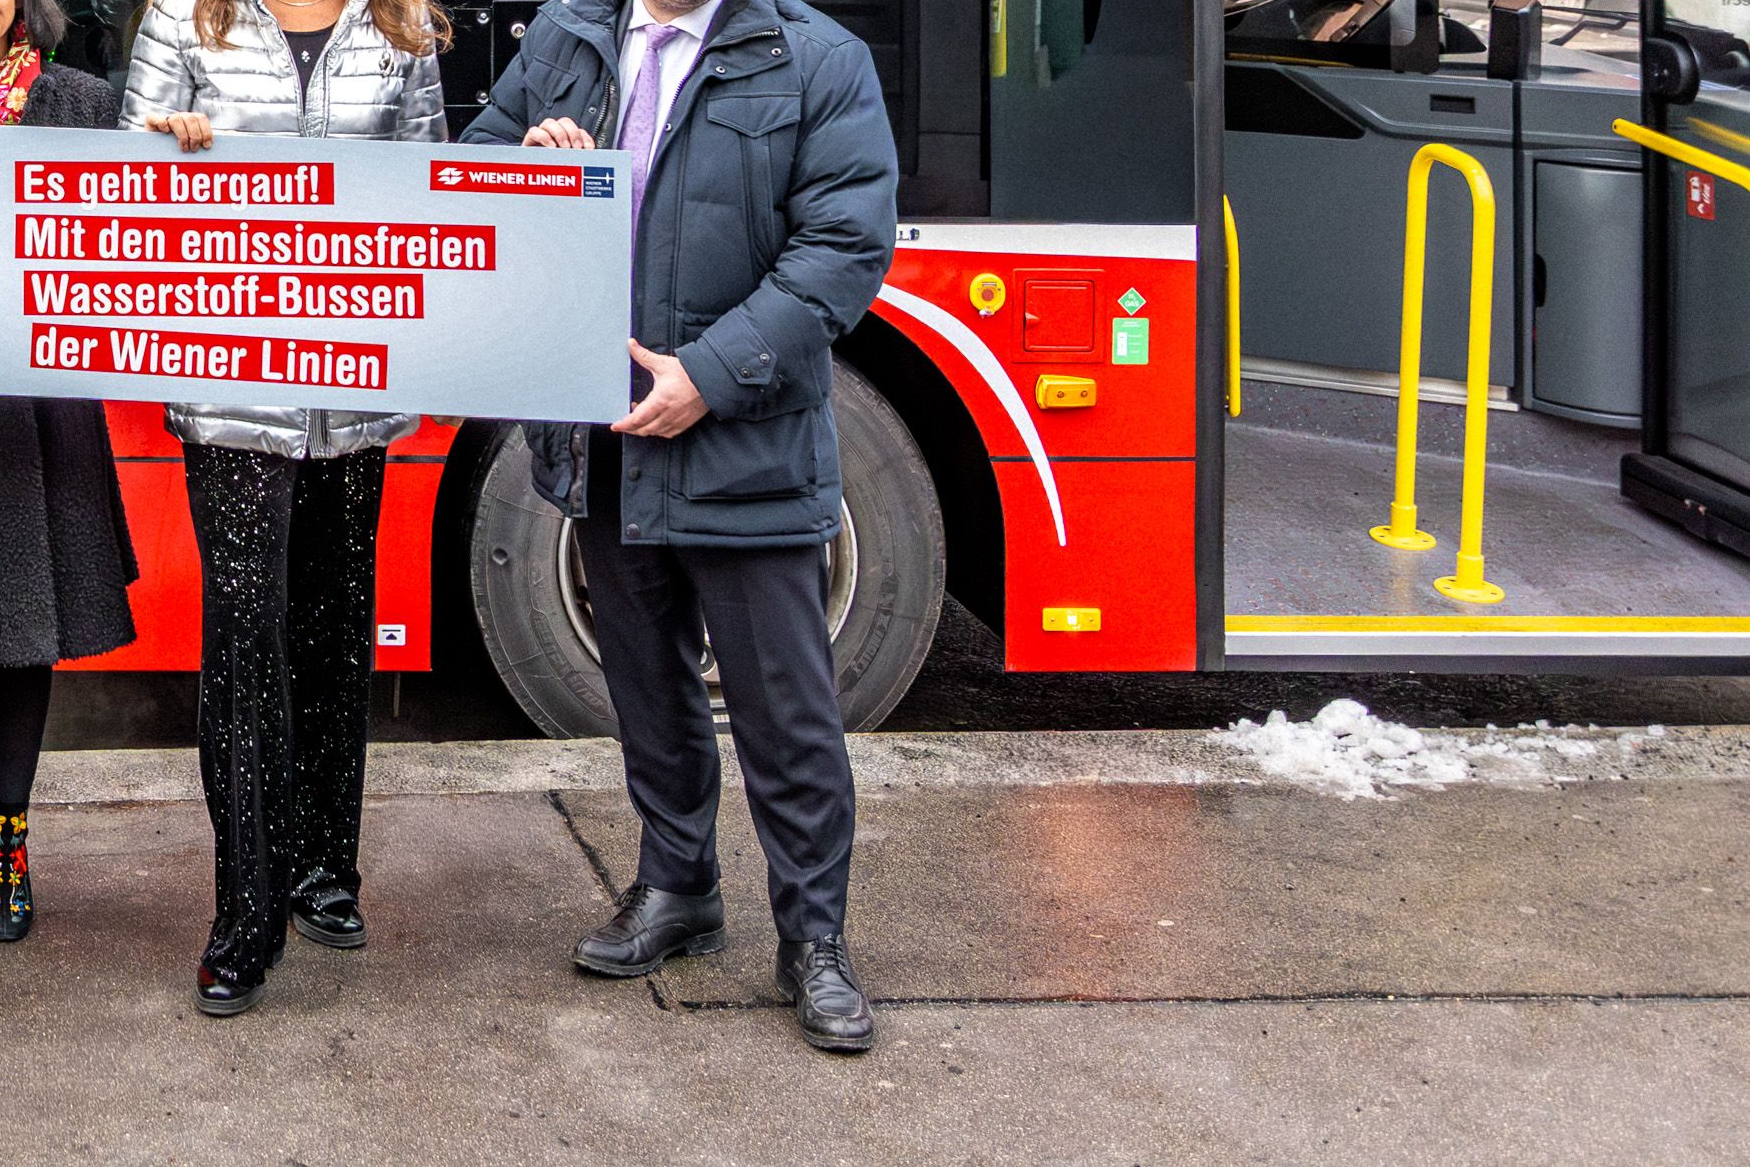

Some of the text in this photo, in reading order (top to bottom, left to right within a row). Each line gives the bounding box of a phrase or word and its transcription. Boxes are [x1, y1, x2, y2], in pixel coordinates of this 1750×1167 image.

[23, 163, 319, 211] Es geht bergauf!
[468, 170, 576, 187] WIENER LINIEN
[23, 216, 486, 269] Mit den emissionsfreien
[31, 273, 417, 317] Wasserstoff-Bussen
[35, 326, 380, 388] der Wiener Linien
